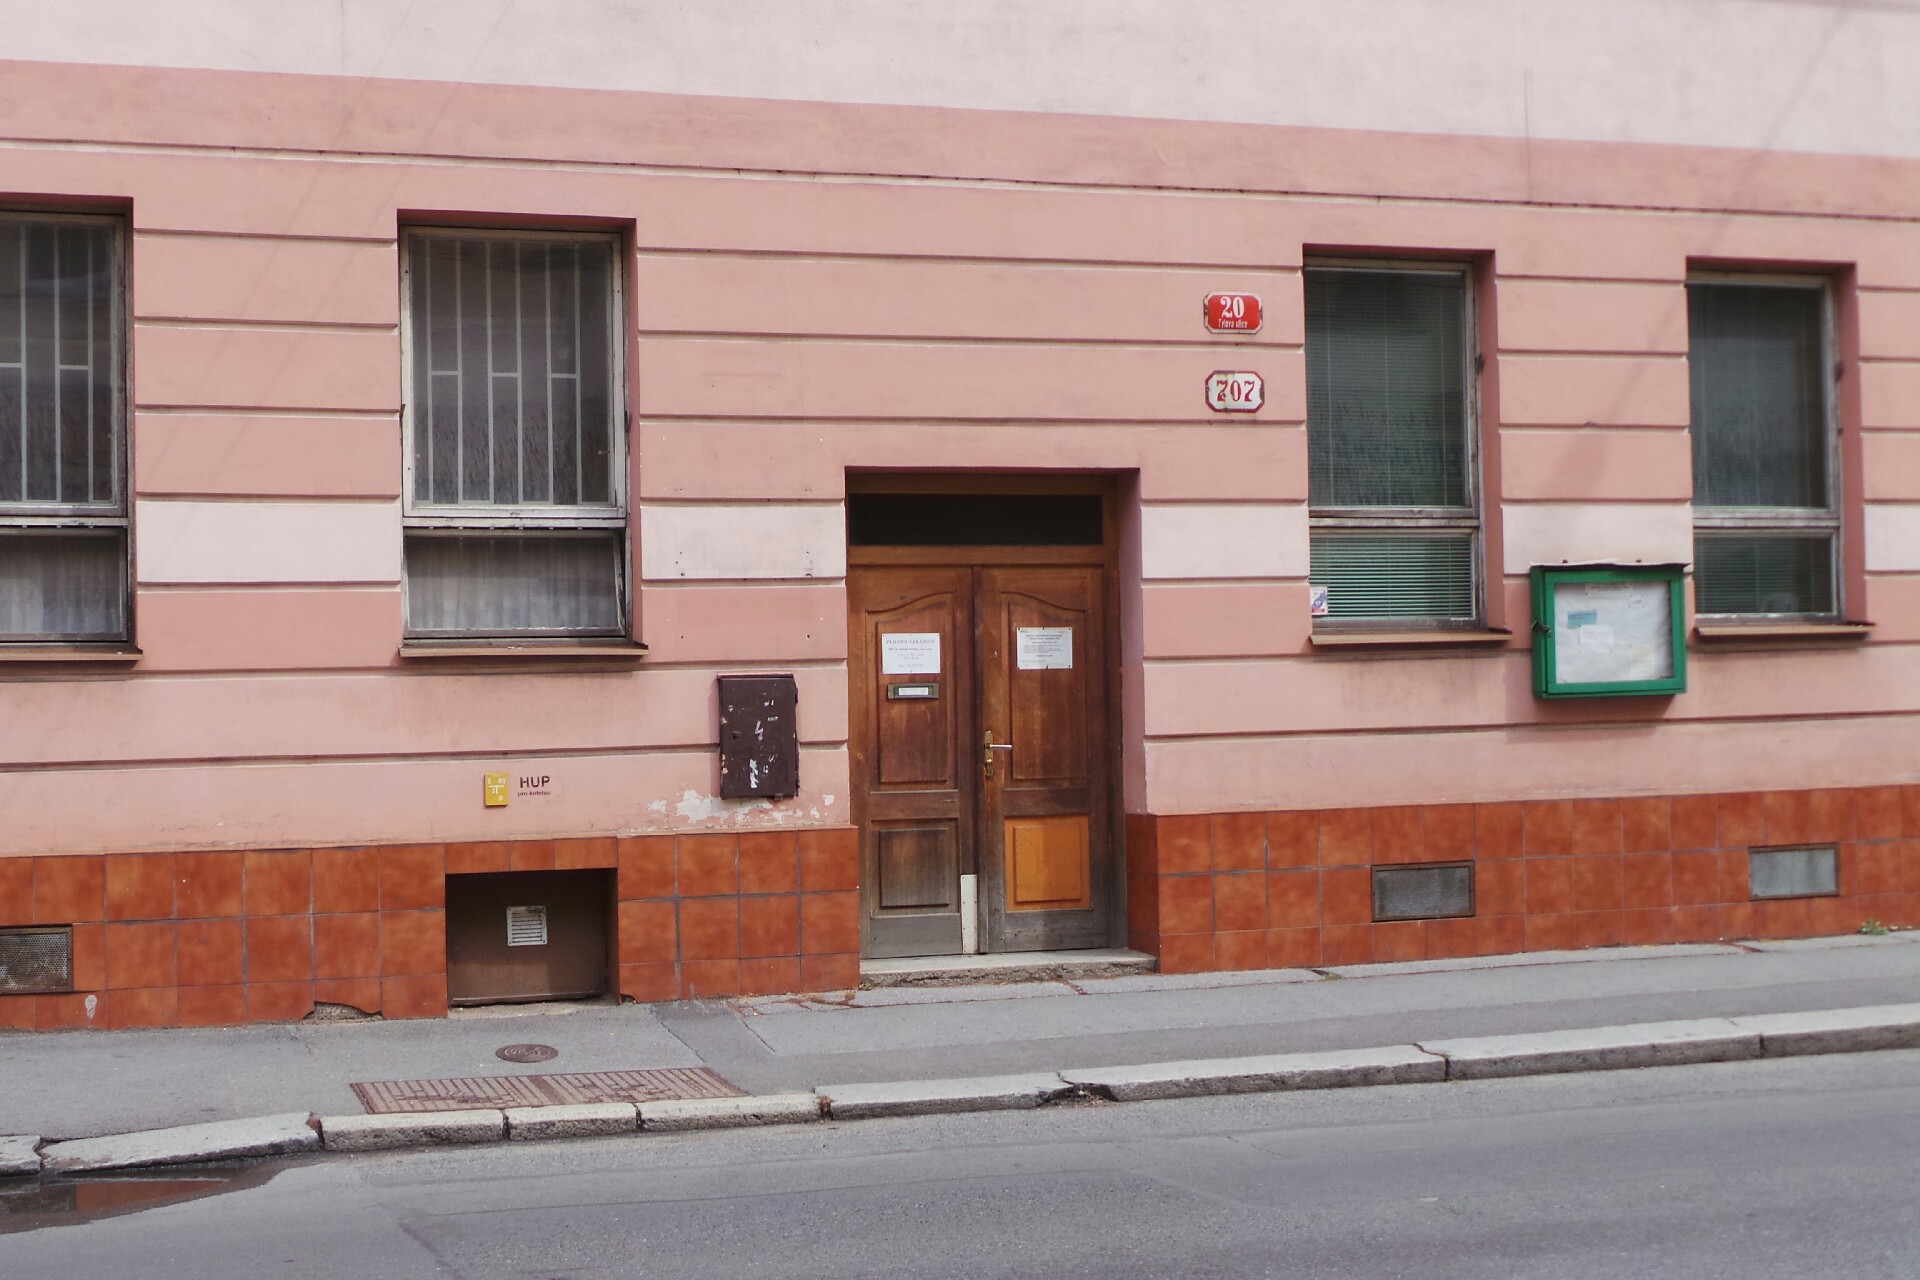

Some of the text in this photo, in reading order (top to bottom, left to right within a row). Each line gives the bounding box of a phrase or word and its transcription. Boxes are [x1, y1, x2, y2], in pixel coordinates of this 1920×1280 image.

[1220, 296, 1245, 318] 20
[1216, 380, 1255, 402] 707
[520, 775, 551, 788] HUP
